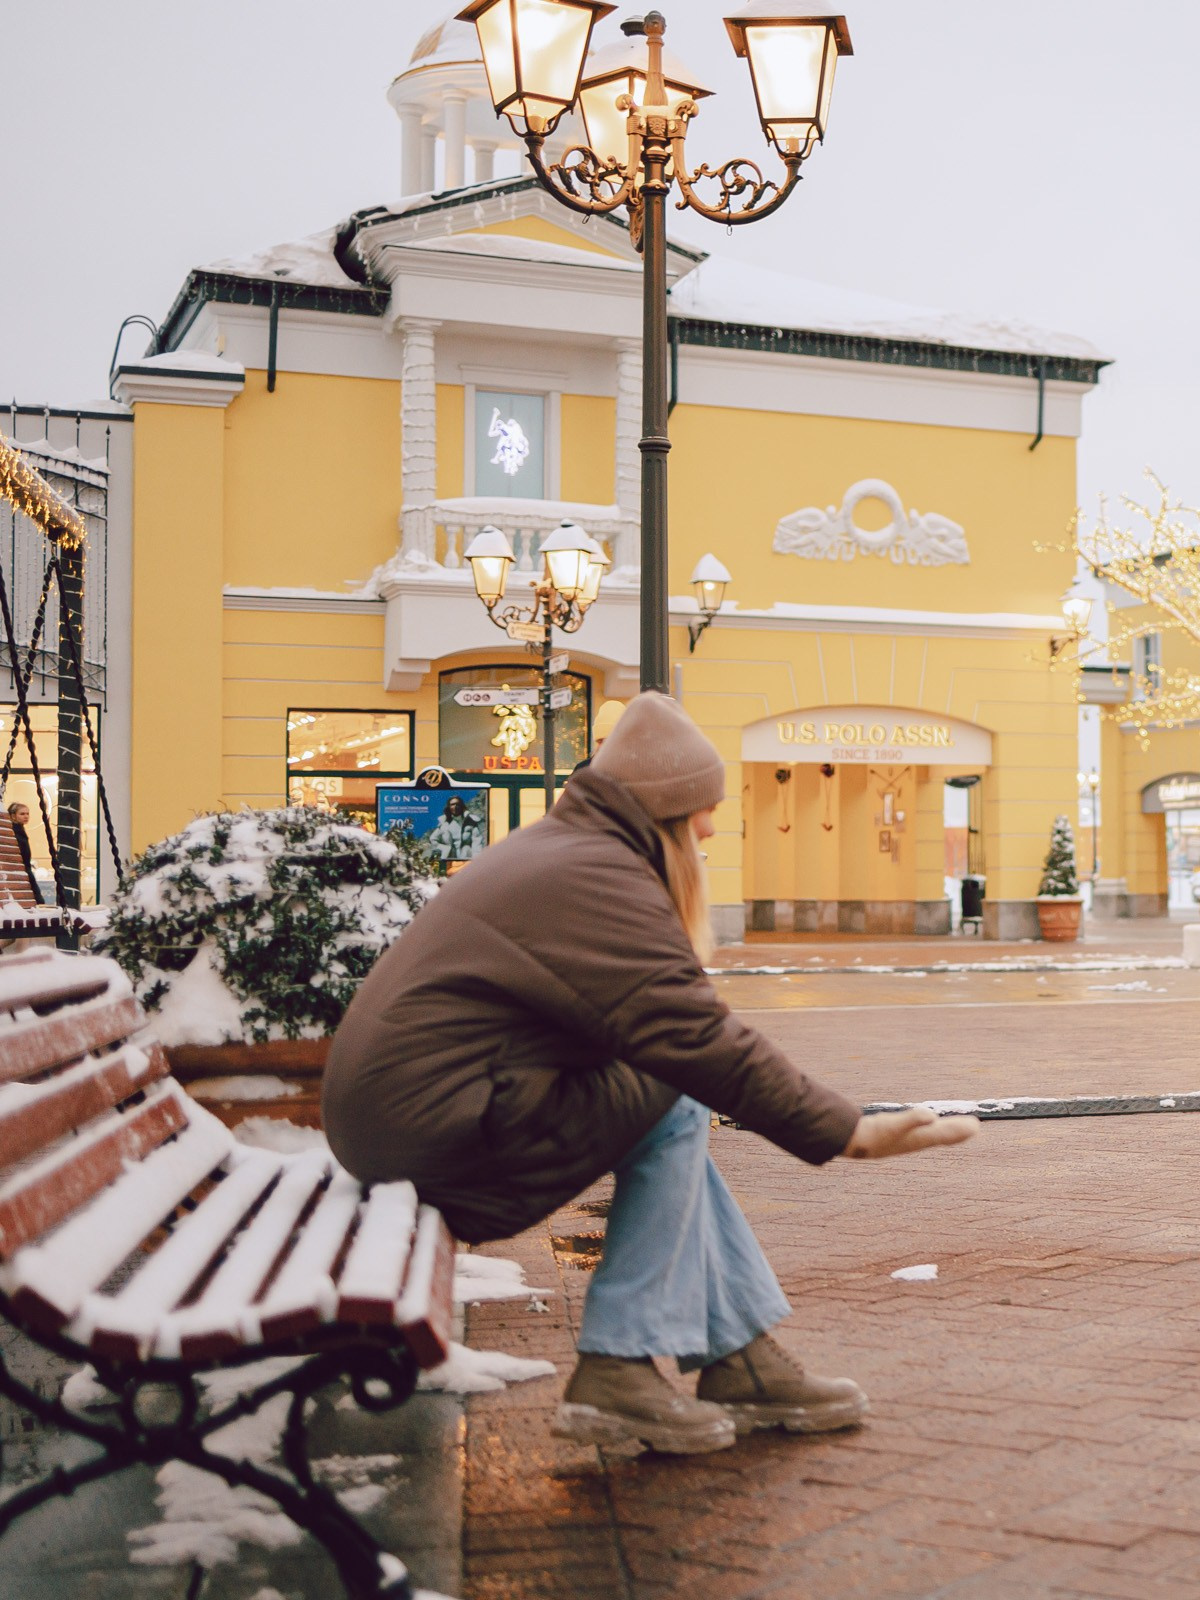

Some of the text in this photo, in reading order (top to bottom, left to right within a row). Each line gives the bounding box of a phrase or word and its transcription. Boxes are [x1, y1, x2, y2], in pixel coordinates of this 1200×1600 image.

[777, 721, 955, 747] U.S. POLO ASSN.
[832, 748, 903, 761] SINCE 1890
[483, 756, 543, 770] USPA
